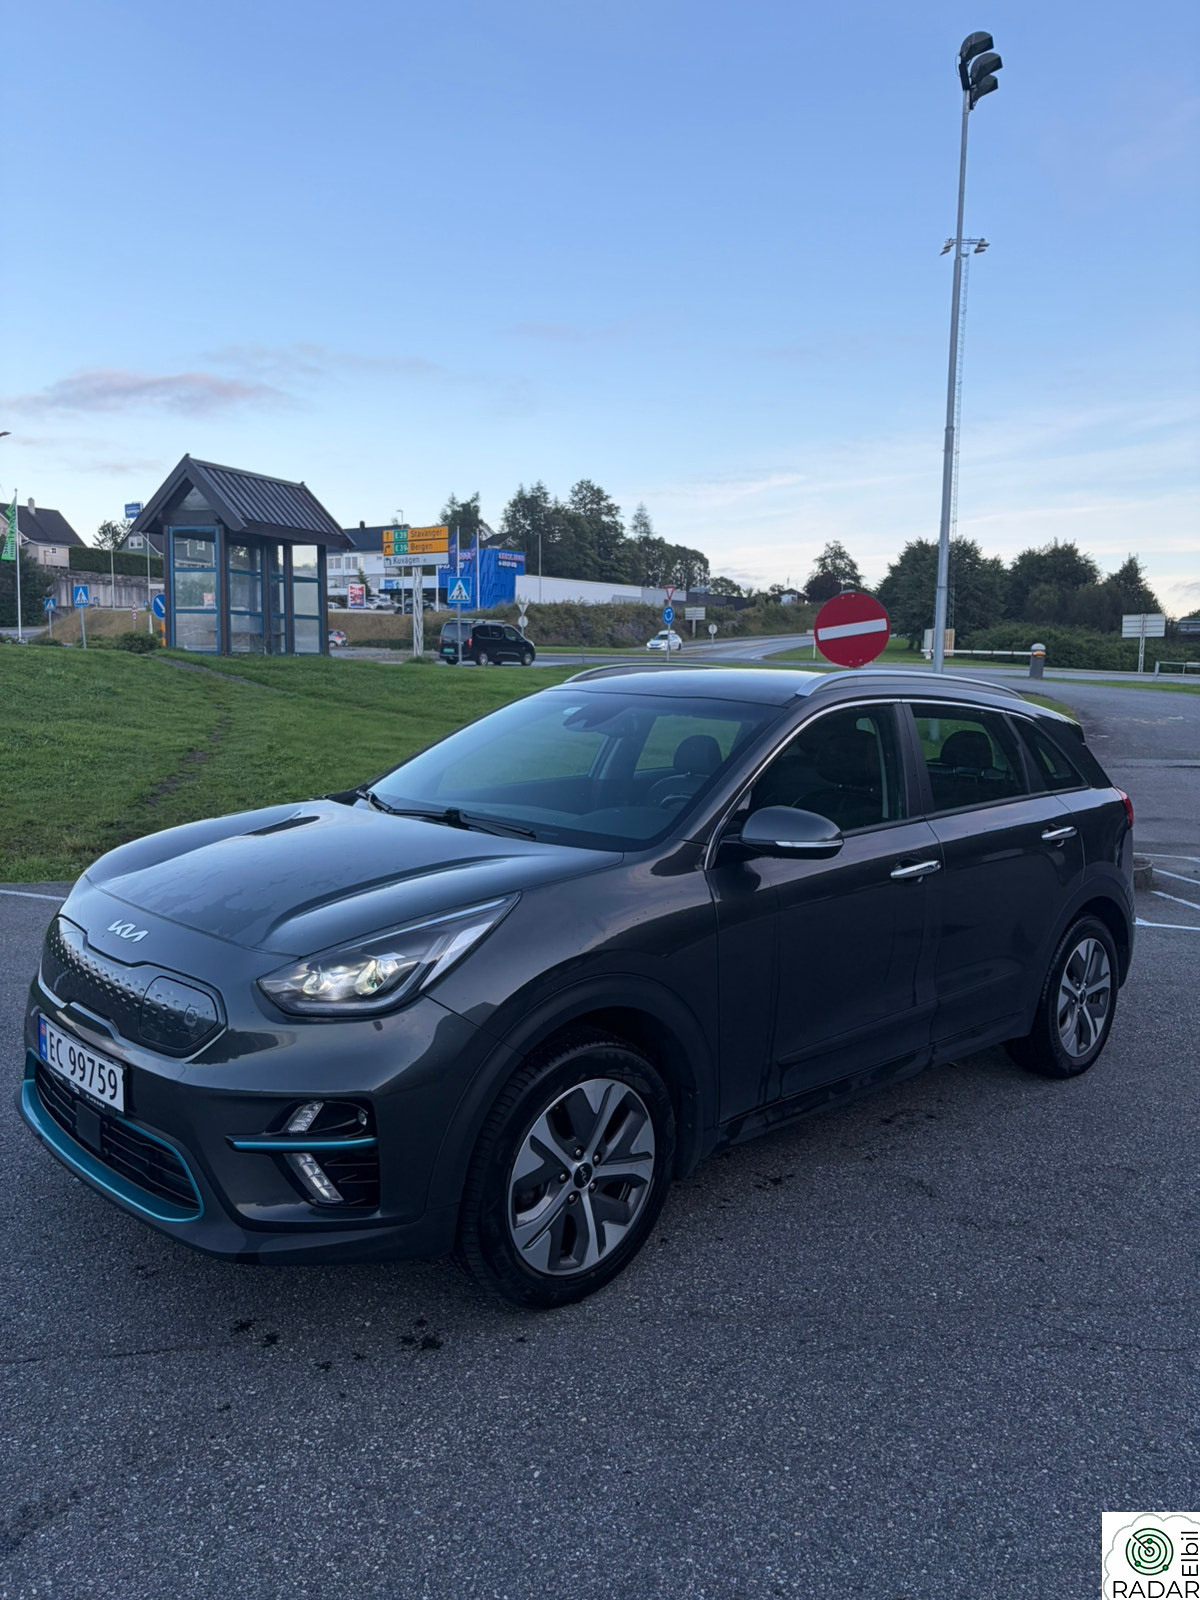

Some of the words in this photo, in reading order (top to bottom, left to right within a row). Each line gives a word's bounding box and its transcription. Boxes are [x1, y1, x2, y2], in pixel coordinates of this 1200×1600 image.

[410, 529, 443, 539] Stavanger
[410, 542, 433, 552] Bergen
[392, 556, 420, 566] Kuvågen
[107, 919, 149, 943] KIA
[49, 1031, 64, 1069] EC
[68, 1046, 118, 1100] 99759
